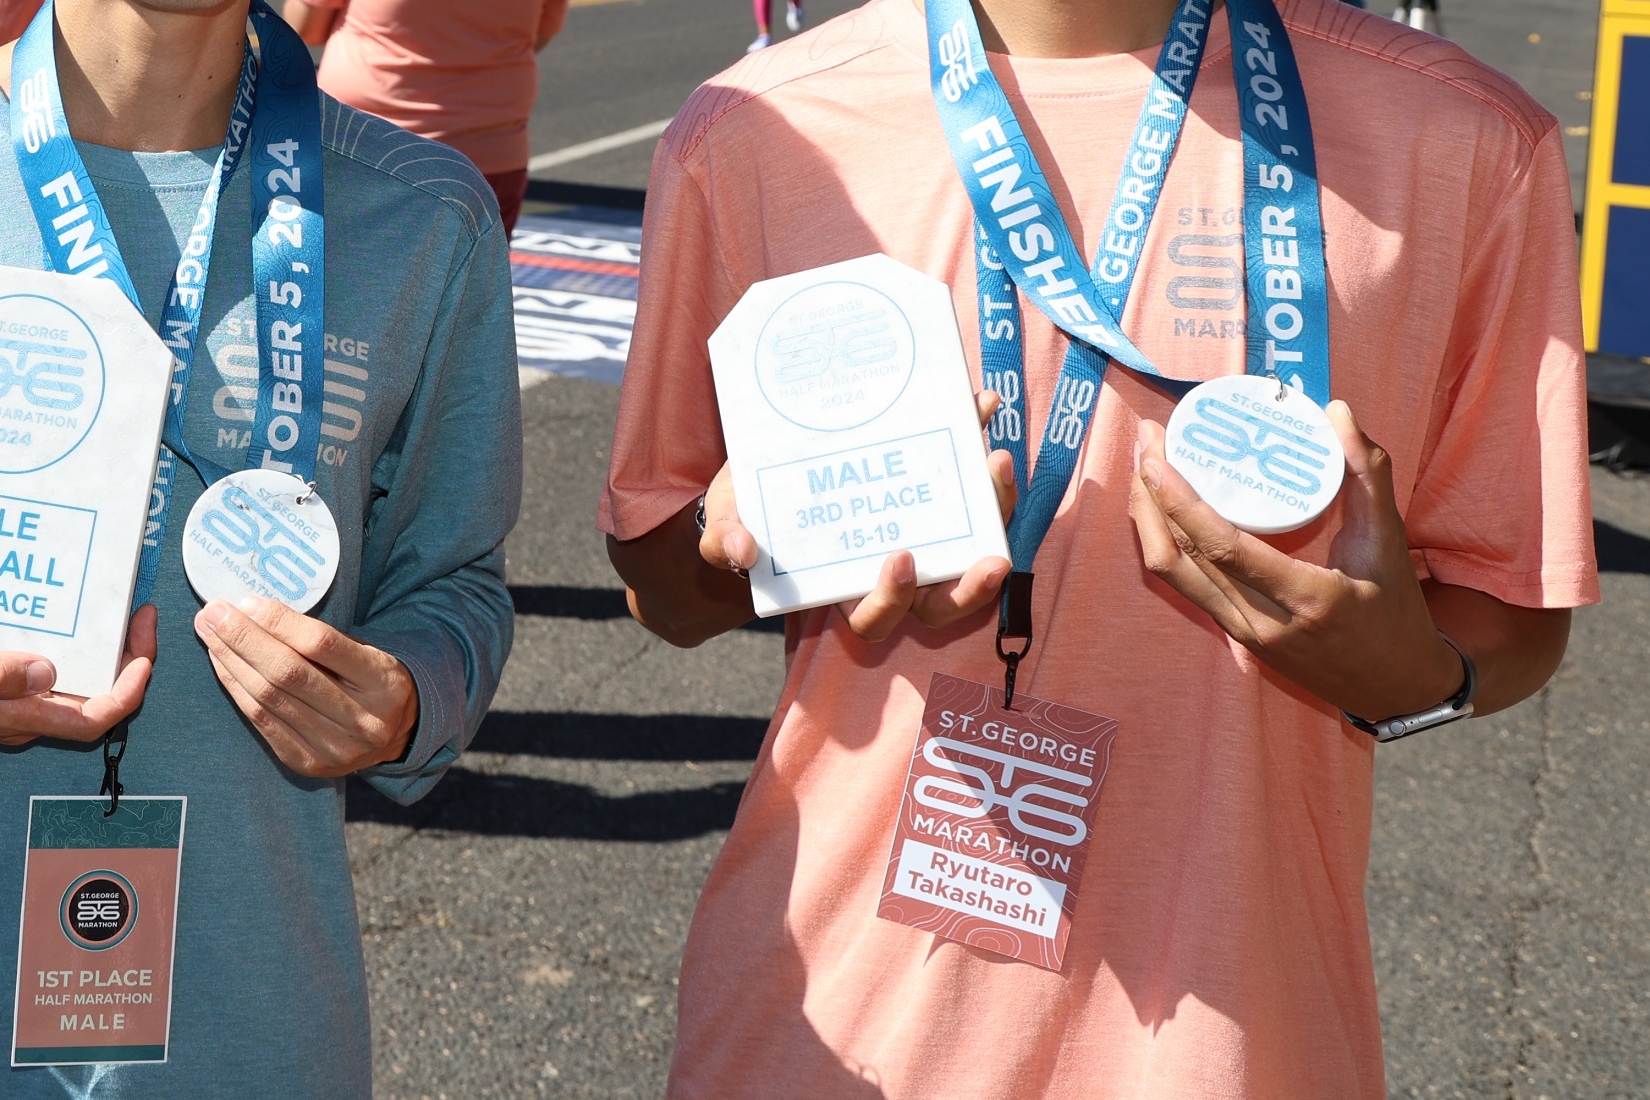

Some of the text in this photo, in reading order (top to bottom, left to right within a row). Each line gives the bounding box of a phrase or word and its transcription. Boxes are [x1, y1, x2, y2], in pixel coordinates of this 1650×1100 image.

[1244, 21, 1288, 131] 2024
[267, 138, 303, 248] 2024
[1100, 125, 1171, 284] GEORGE
[959, 114, 1120, 350] FINISHER
[1261, 205, 1304, 393] TOBER
[261, 320, 303, 473] TOBER
[1230, 392, 1315, 435] ST.GEORGE
[806, 450, 908, 495] MALE
[1174, 445, 1310, 513] HALF MARATHON
[795, 483, 933, 530] 3RD PLACE
[188, 529, 223, 558] HALF
[839, 522, 900, 551] 15-19
[938, 710, 1097, 768] ST.GEORGE
[912, 813, 1072, 873] MARATHON
[80, 892, 119, 900] ST.GEORGE
[907, 869, 1047, 927] Takashashi
[930, 851, 1033, 897] Ryutaro
[34, 993, 152, 1006] HALF MARATHON
[37, 969, 152, 988] 1ST PLACE
[60, 1013, 125, 1031] MALE
